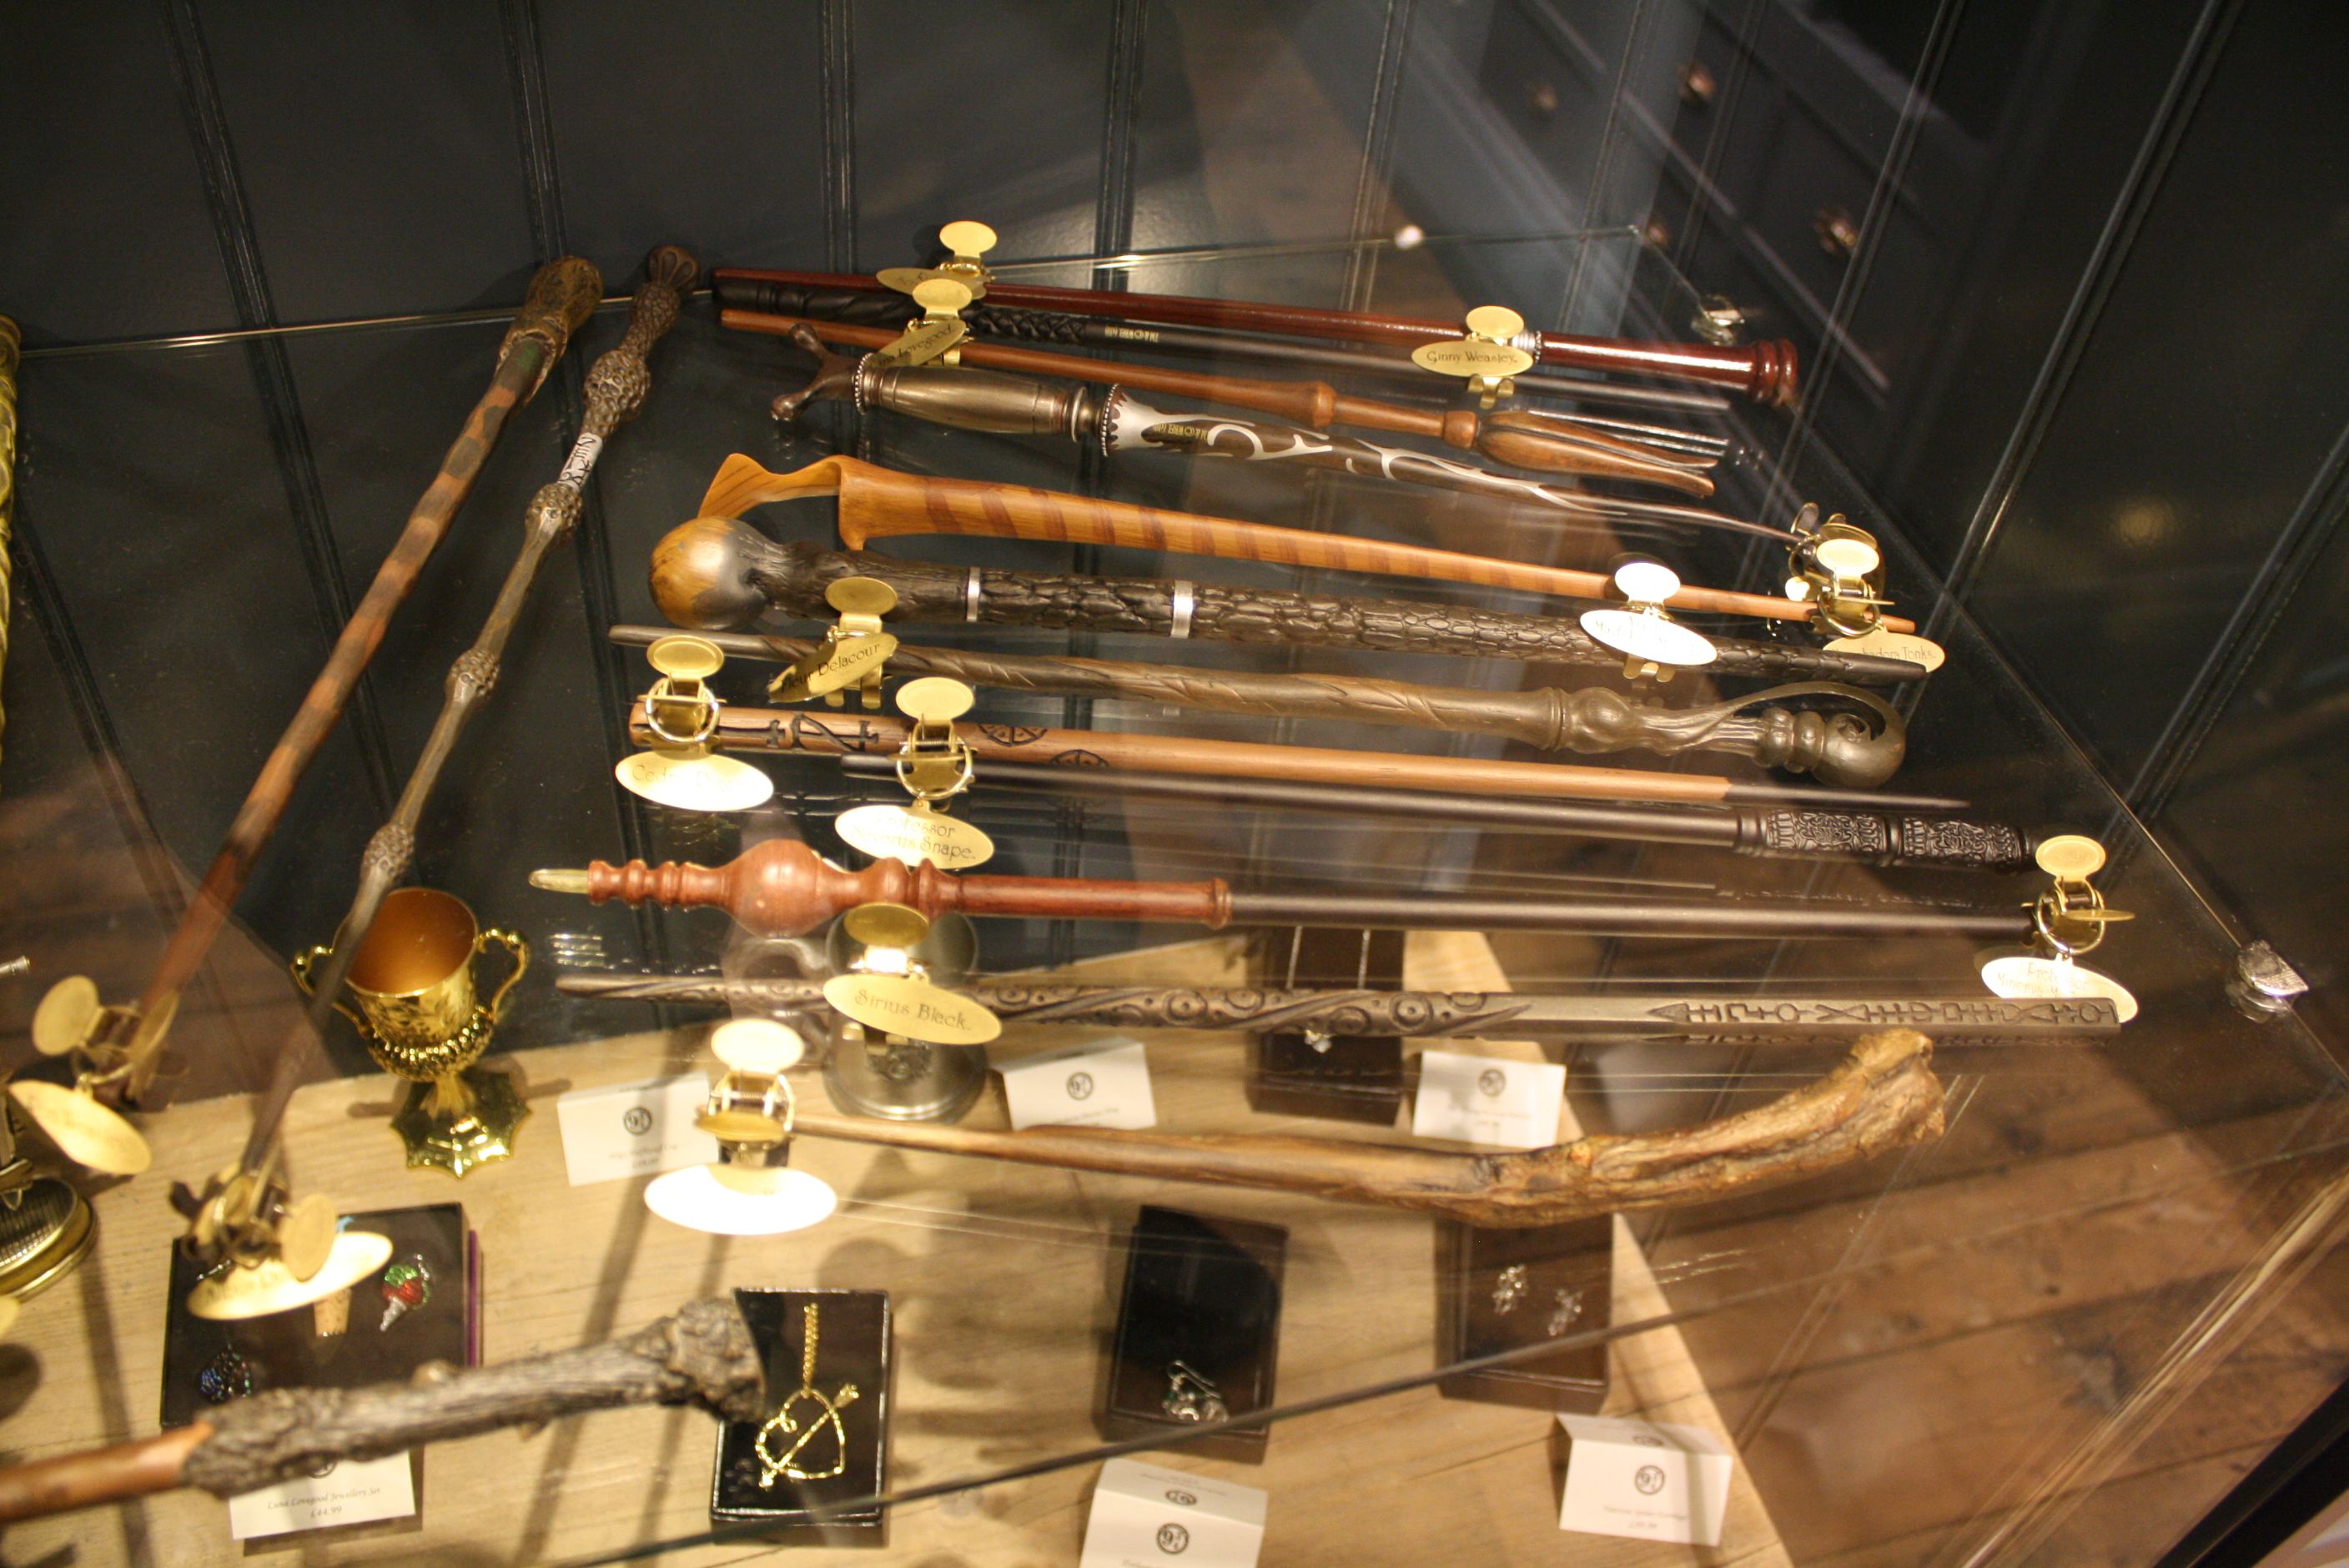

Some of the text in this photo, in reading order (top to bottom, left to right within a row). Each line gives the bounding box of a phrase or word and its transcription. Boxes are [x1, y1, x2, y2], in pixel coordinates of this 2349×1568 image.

[898, 324, 952, 358] Lovegood
[1426, 350, 1461, 364] Ginny
[817, 643, 881, 676] Delacour
[877, 813, 956, 837] rofessor
[853, 988, 910, 1015] Sirius
